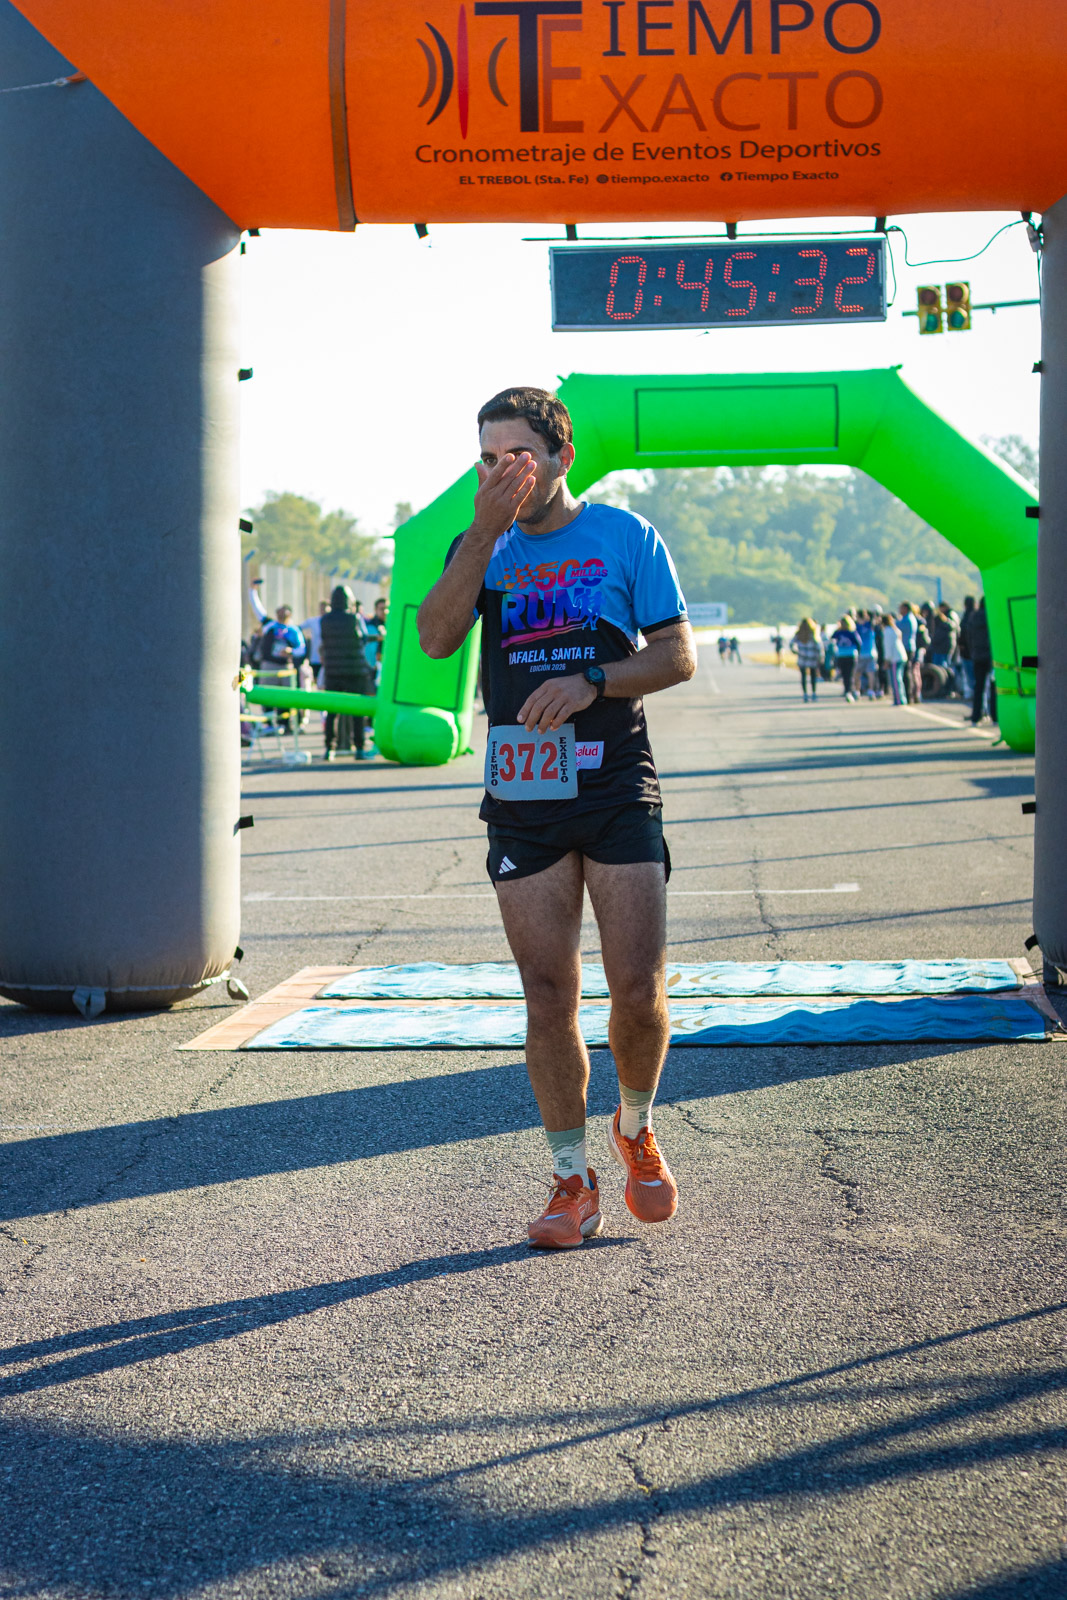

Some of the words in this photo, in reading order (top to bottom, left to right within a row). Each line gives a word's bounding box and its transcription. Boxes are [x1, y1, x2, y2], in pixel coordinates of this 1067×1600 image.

[415, 143, 586, 166] Cronometraje
[593, 142, 624, 161] de
[632, 142, 732, 161] Eventos
[740, 139, 881, 162] Deportivos
[459, 175, 475, 185] EL
[477, 175, 531, 185] TREBOL
[535, 174, 566, 186] (Sta.
[569, 174, 589, 185] Fe)
[611, 173, 710, 184] tiempo.exacto
[735, 171, 790, 183] Tiempo
[792, 171, 839, 181] Exacto
[605, 247, 876, 321] 0:45:32
[570, 569, 608, 578] MILLAS
[551, 647, 582, 660] SANTA
[583, 646, 595, 660] FE
[529, 664, 551, 673] EDICIÓN
[490, 741, 499, 786] TIEMPO
[499, 741, 559, 782] 372
[559, 736, 569, 783] EXACTO
